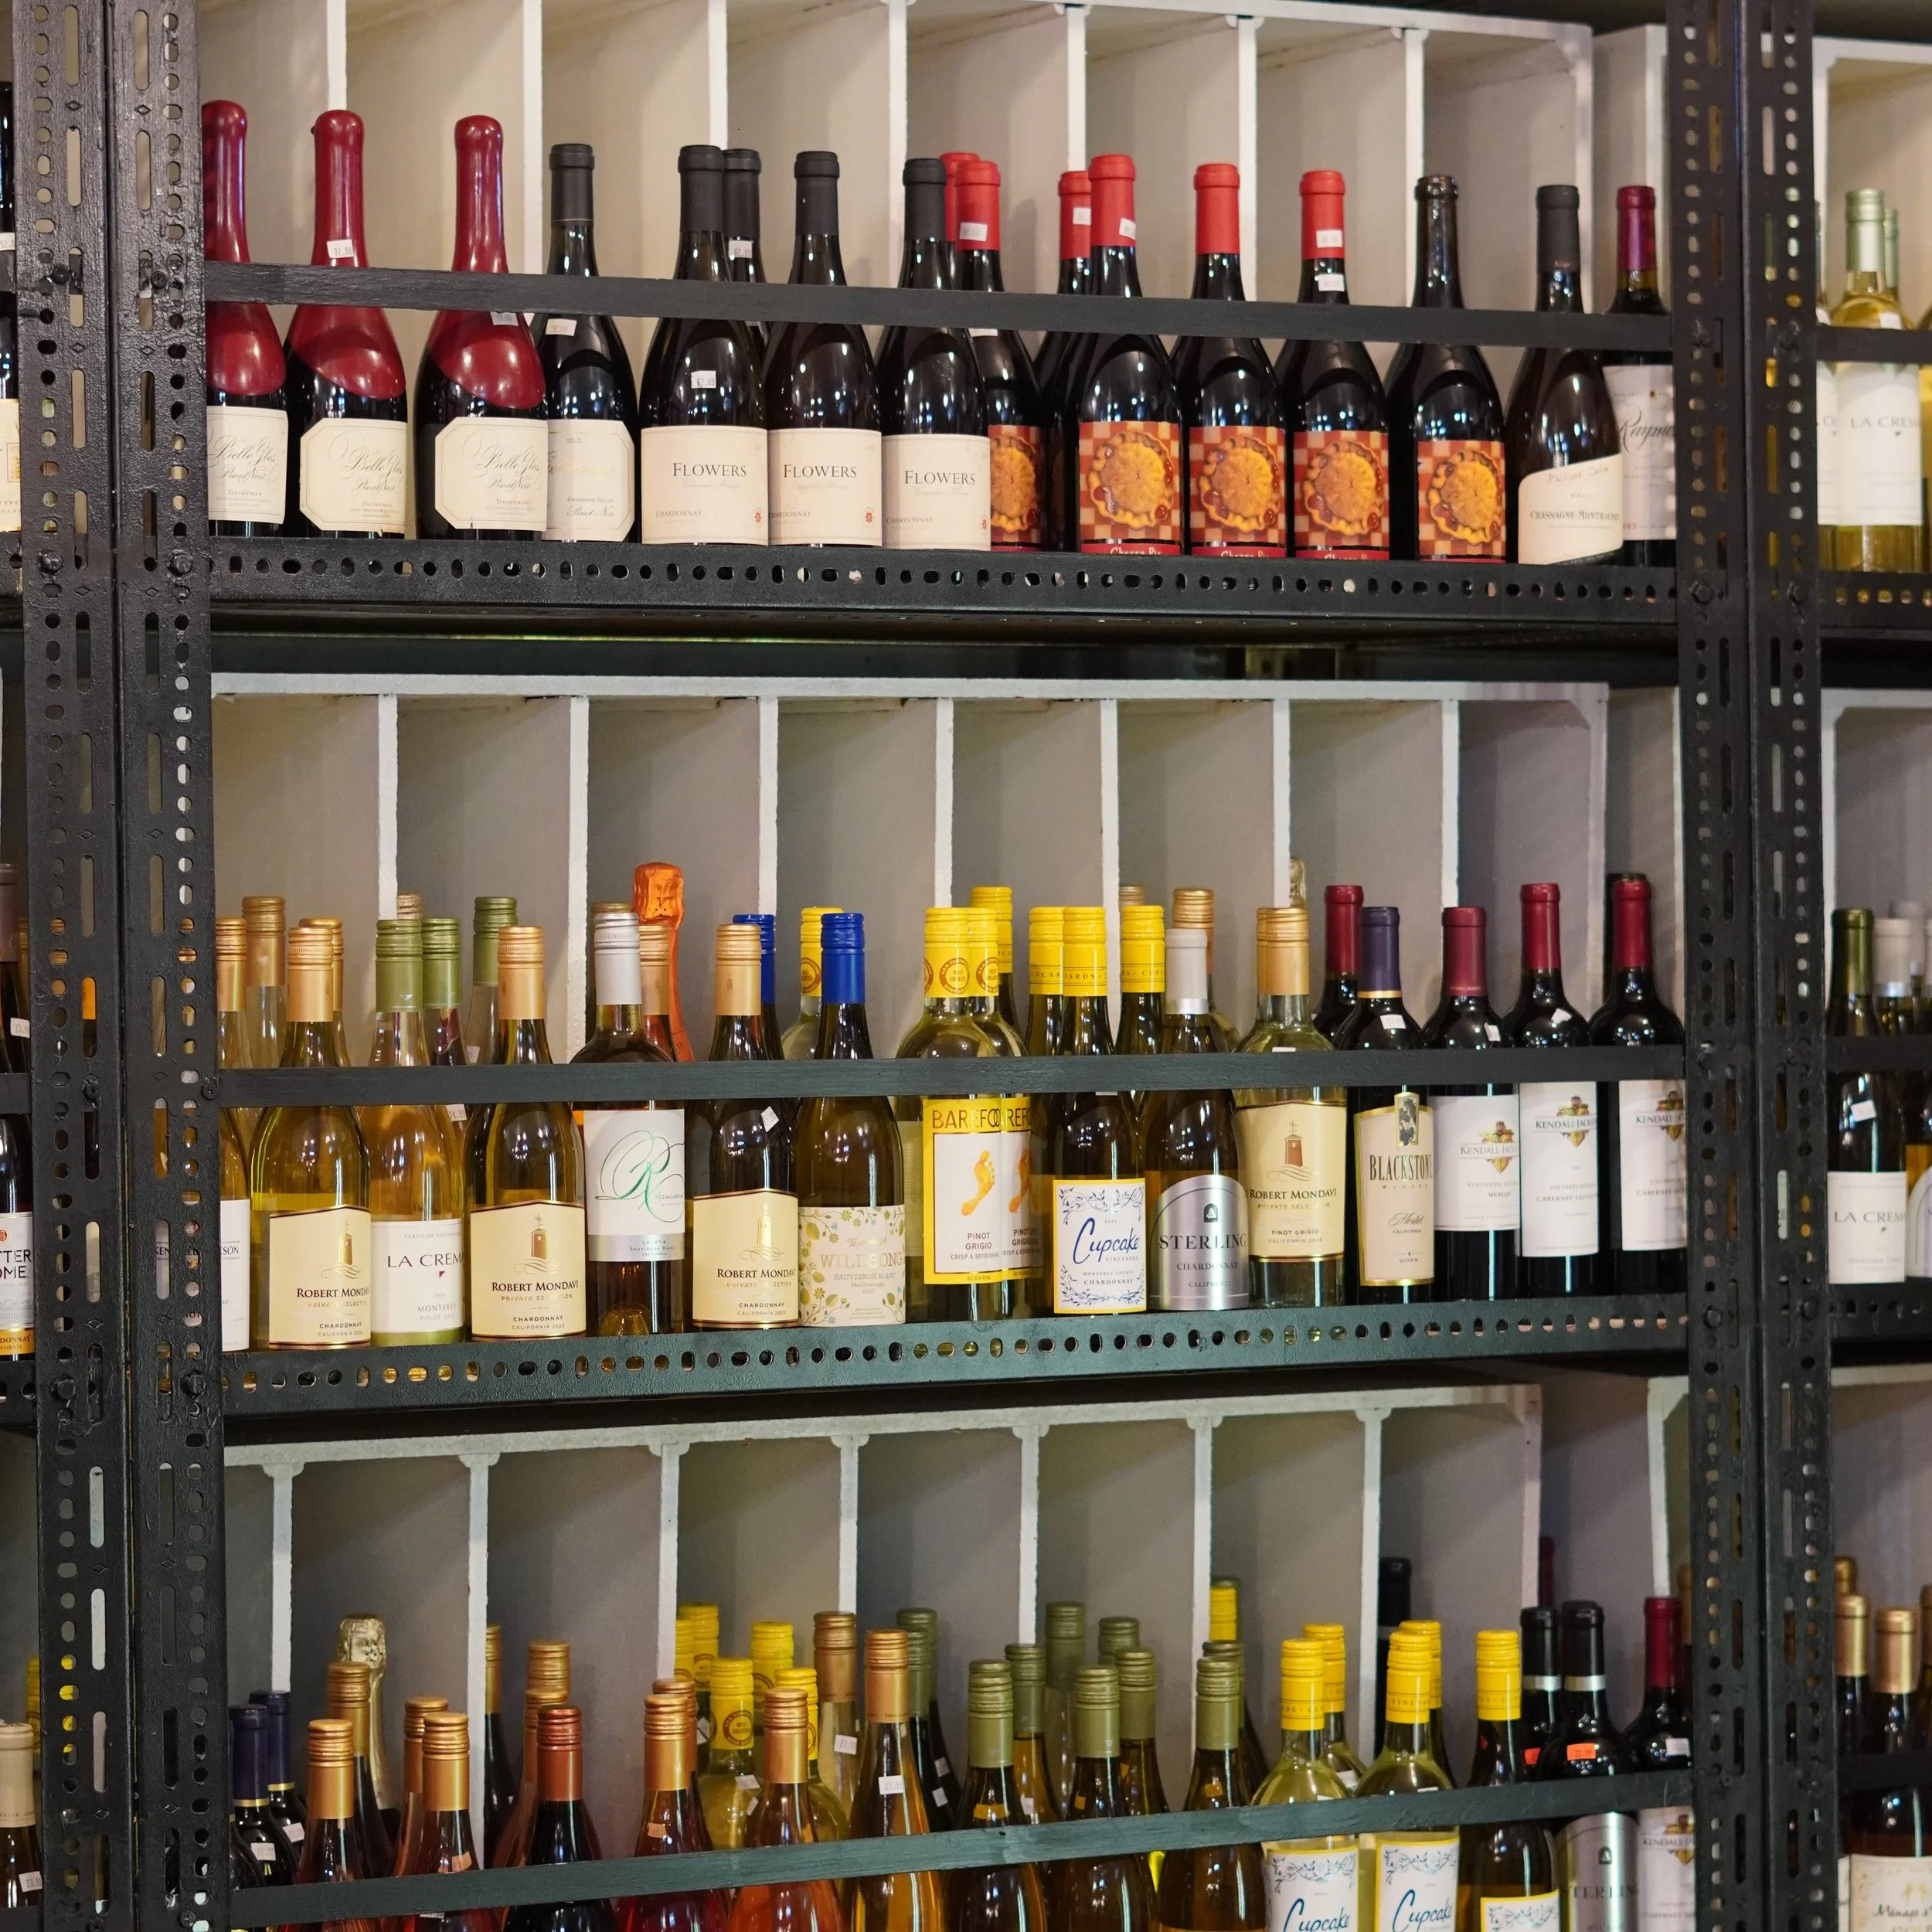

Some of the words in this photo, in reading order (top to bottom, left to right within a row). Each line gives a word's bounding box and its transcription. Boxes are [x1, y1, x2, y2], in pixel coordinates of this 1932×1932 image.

[672, 462, 747, 478] FLOWERS
[784, 464, 857, 478] FLOWERS
[905, 470, 975, 485] FLOWERS
[1369, 1152, 1434, 1181] BLACKSTONE
[1250, 1189, 1288, 1200] ROBERT
[1291, 1188, 1337, 1199] MONDAVI
[1834, 1211, 1857, 1223] LA
[967, 1232, 992, 1240] PINOT
[1073, 1216, 1140, 1264] Cupcake
[1159, 1233, 1247, 1250] STERLING
[965, 1242, 992, 1250] GRIGIO
[387, 1254, 413, 1268] LA
[1176, 1260, 1238, 1271] CHARDONNAY
[717, 1267, 757, 1278] ROBERT
[492, 1281, 532, 1292] ROBERT
[535, 1280, 579, 1291] MONDAVI
[297, 1287, 338, 1298] ROBERT
[417, 1304, 457, 1312] MONTEREY
